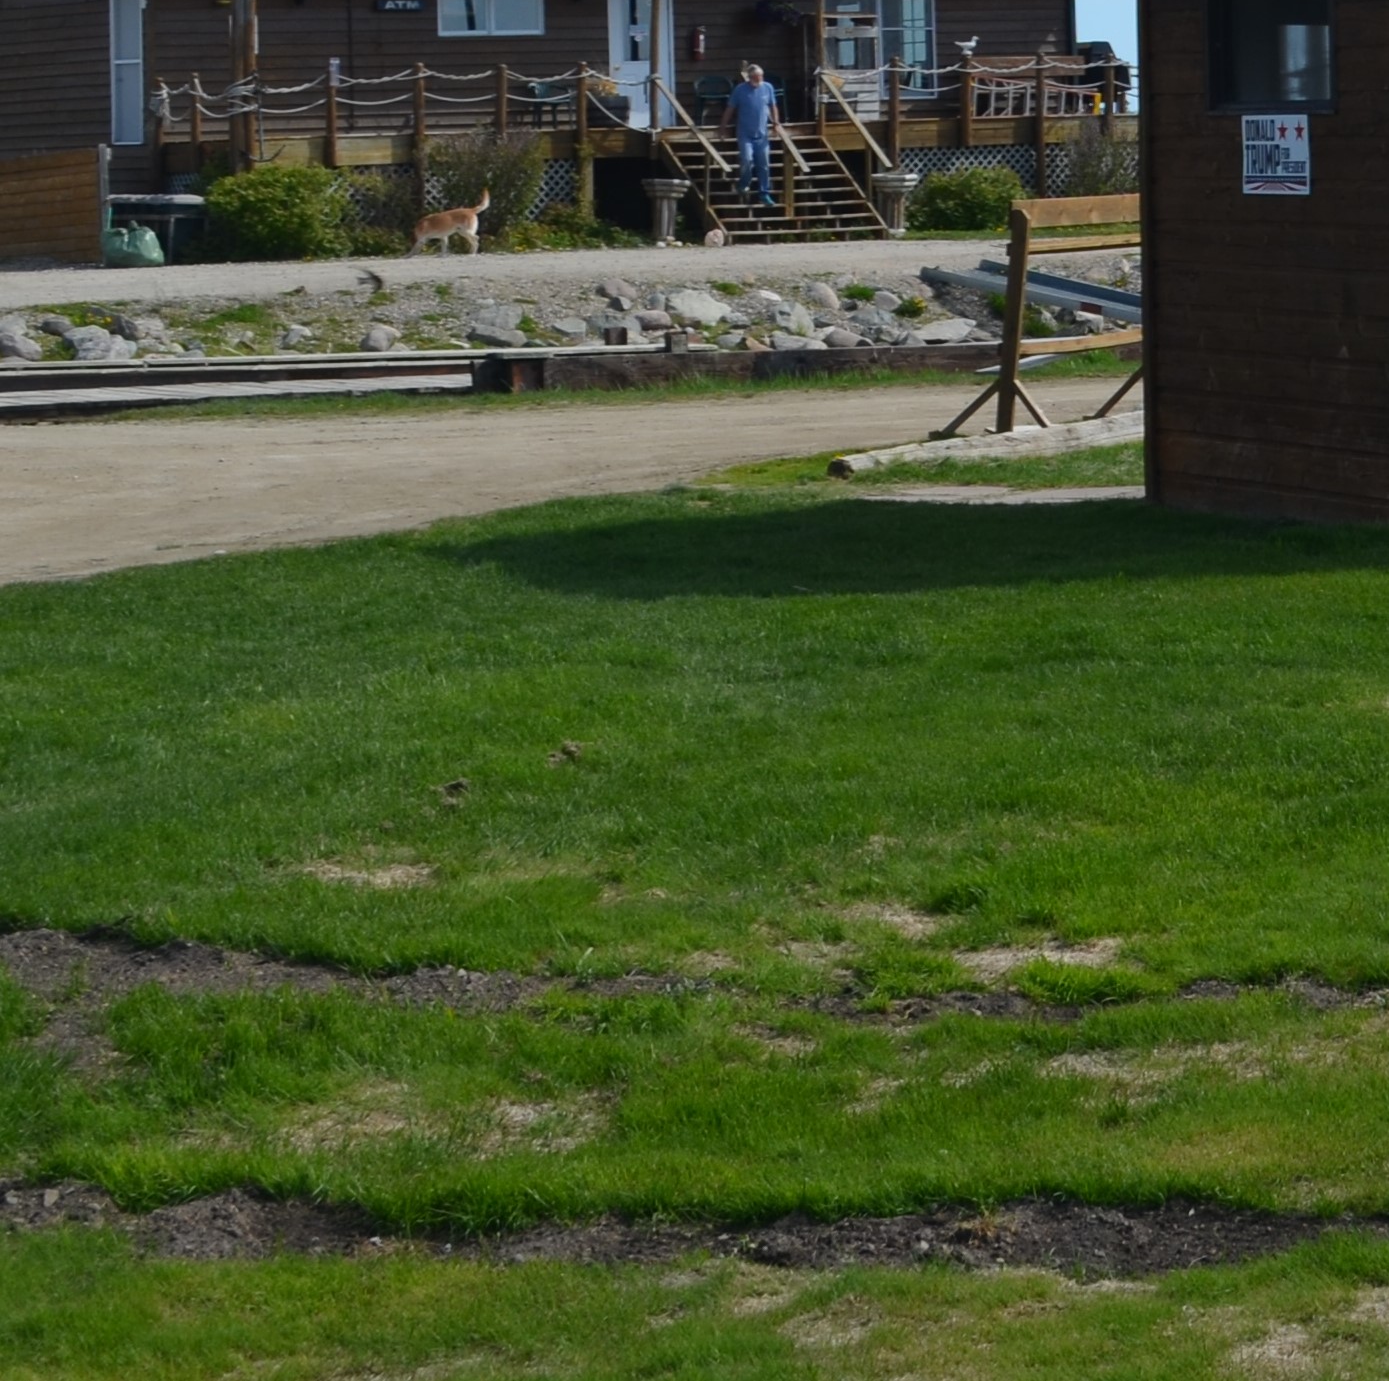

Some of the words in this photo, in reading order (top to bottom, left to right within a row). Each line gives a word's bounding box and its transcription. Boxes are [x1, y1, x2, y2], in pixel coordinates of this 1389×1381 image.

[384, 0, 420, 10] ATM
[1245, 119, 1275, 141] DONALD
[1245, 143, 1280, 174] TRUMP
